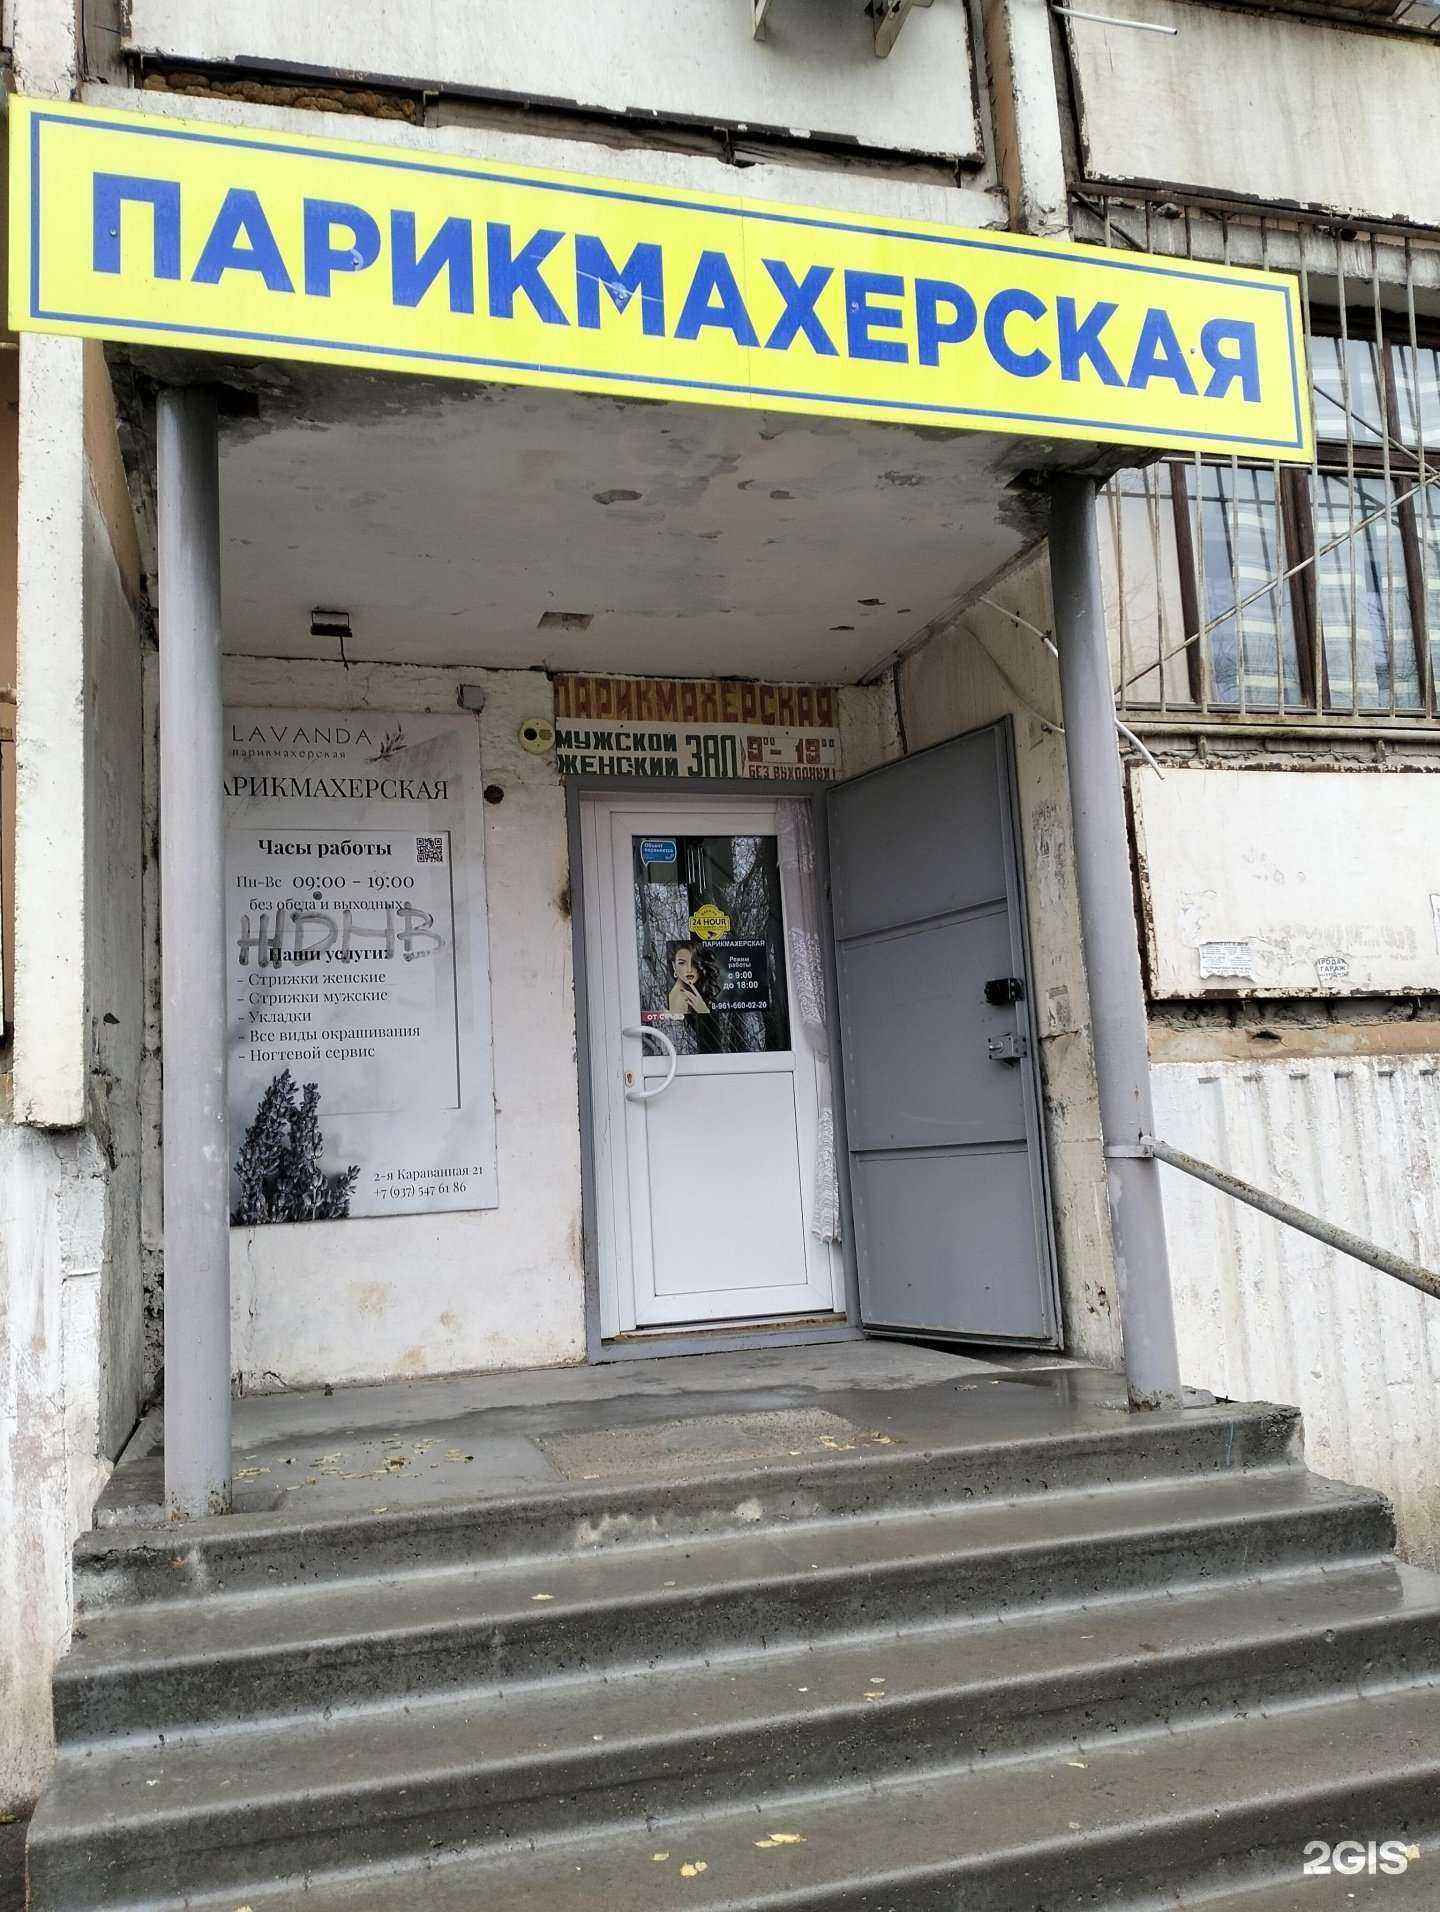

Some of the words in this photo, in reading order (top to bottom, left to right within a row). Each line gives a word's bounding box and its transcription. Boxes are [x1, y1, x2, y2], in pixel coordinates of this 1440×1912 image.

[92, 171, 1263, 404] ПАРИКМАХЕРСКАЯ
[553, 676, 834, 728] ПАРИКМАХЕРСКАЯ
[231, 724, 373, 745] LAVANDA
[556, 729, 678, 752] МУЖСКОЙ
[685, 733, 739, 778] ЗАЛ
[748, 764, 770, 778] БЕЗ
[224, 776, 449, 800] РИКМАХЕРСКАЯ
[258, 839, 312, 855] Часы
[318, 839, 392, 858] работы
[236, 875, 282, 889] Пн-Вс
[292, 874, 346, 889] 09:00
[367, 876, 415, 889] 19:00
[249, 899, 273, 911] без
[276, 899, 317, 913] обеда
[320, 901, 329, 911] и
[333, 901, 402, 912] выходных
[692, 918, 702, 926] 24
[703, 918, 727, 926] HOUR
[269, 948, 321, 963] Наши
[325, 948, 389, 965] услуги:
[248, 972, 319, 988] Стрижки
[322, 972, 387, 984] женские
[734, 971, 753, 980] 9:00
[723, 982, 735, 991] до
[248, 992, 319, 1007] Стрижки
[323, 990, 389, 1004] мужские
[249, 1009, 312, 1024] Укладки
[250, 1030, 276, 1043] Все
[279, 1030, 318, 1043] виды
[321, 1026, 421, 1041] окрашивания
[250, 1046, 322, 1063] Ногтевой
[325, 1046, 376, 1061] сервис
[373, 1171, 394, 1182] 2-я
[397, 1167, 470, 1181] Караванная
[472, 1166, 484, 1176] 21
[373, 1187, 387, 1200] +7
[389, 1183, 416, 1201] (937)
[418, 1184, 436, 1198] 547
[438, 1184, 450, 1196] 61
[453, 1181, 467, 1194] 86
